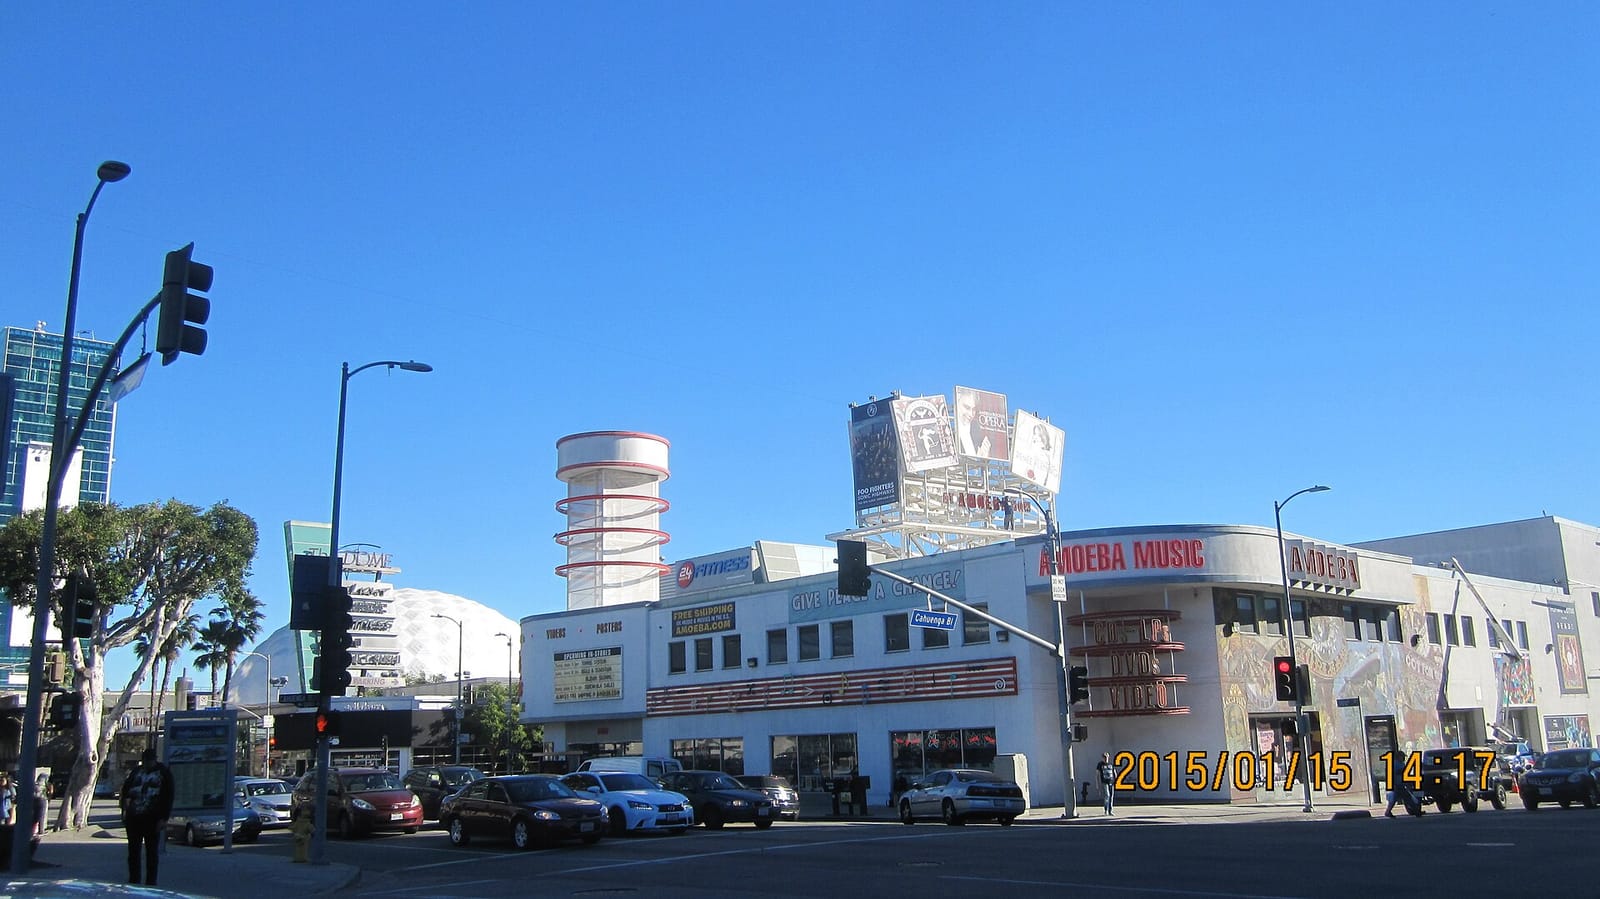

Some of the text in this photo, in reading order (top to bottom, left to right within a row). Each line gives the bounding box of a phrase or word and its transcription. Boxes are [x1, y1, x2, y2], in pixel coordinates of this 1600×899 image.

[857, 482, 895, 496] FOO FIGHTERS
[344, 552, 393, 569] DOME
[1039, 539, 1204, 576] AMOEBA MUSIC
[1290, 546, 1360, 583] AMOEBA
[679, 556, 750, 579] 24 FITNESS
[792, 591, 821, 611] GIVE
[875, 582, 886, 600] A
[892, 570, 961, 597] CHANCE!
[674, 604, 734, 620] FREE SHIPPING
[914, 613, 944, 626] Cahuenga
[546, 621, 622, 640] VIDEOS POSTERS
[676, 620, 731, 634] AMOEBA.COM
[1110, 680, 1168, 711] VIDEO
